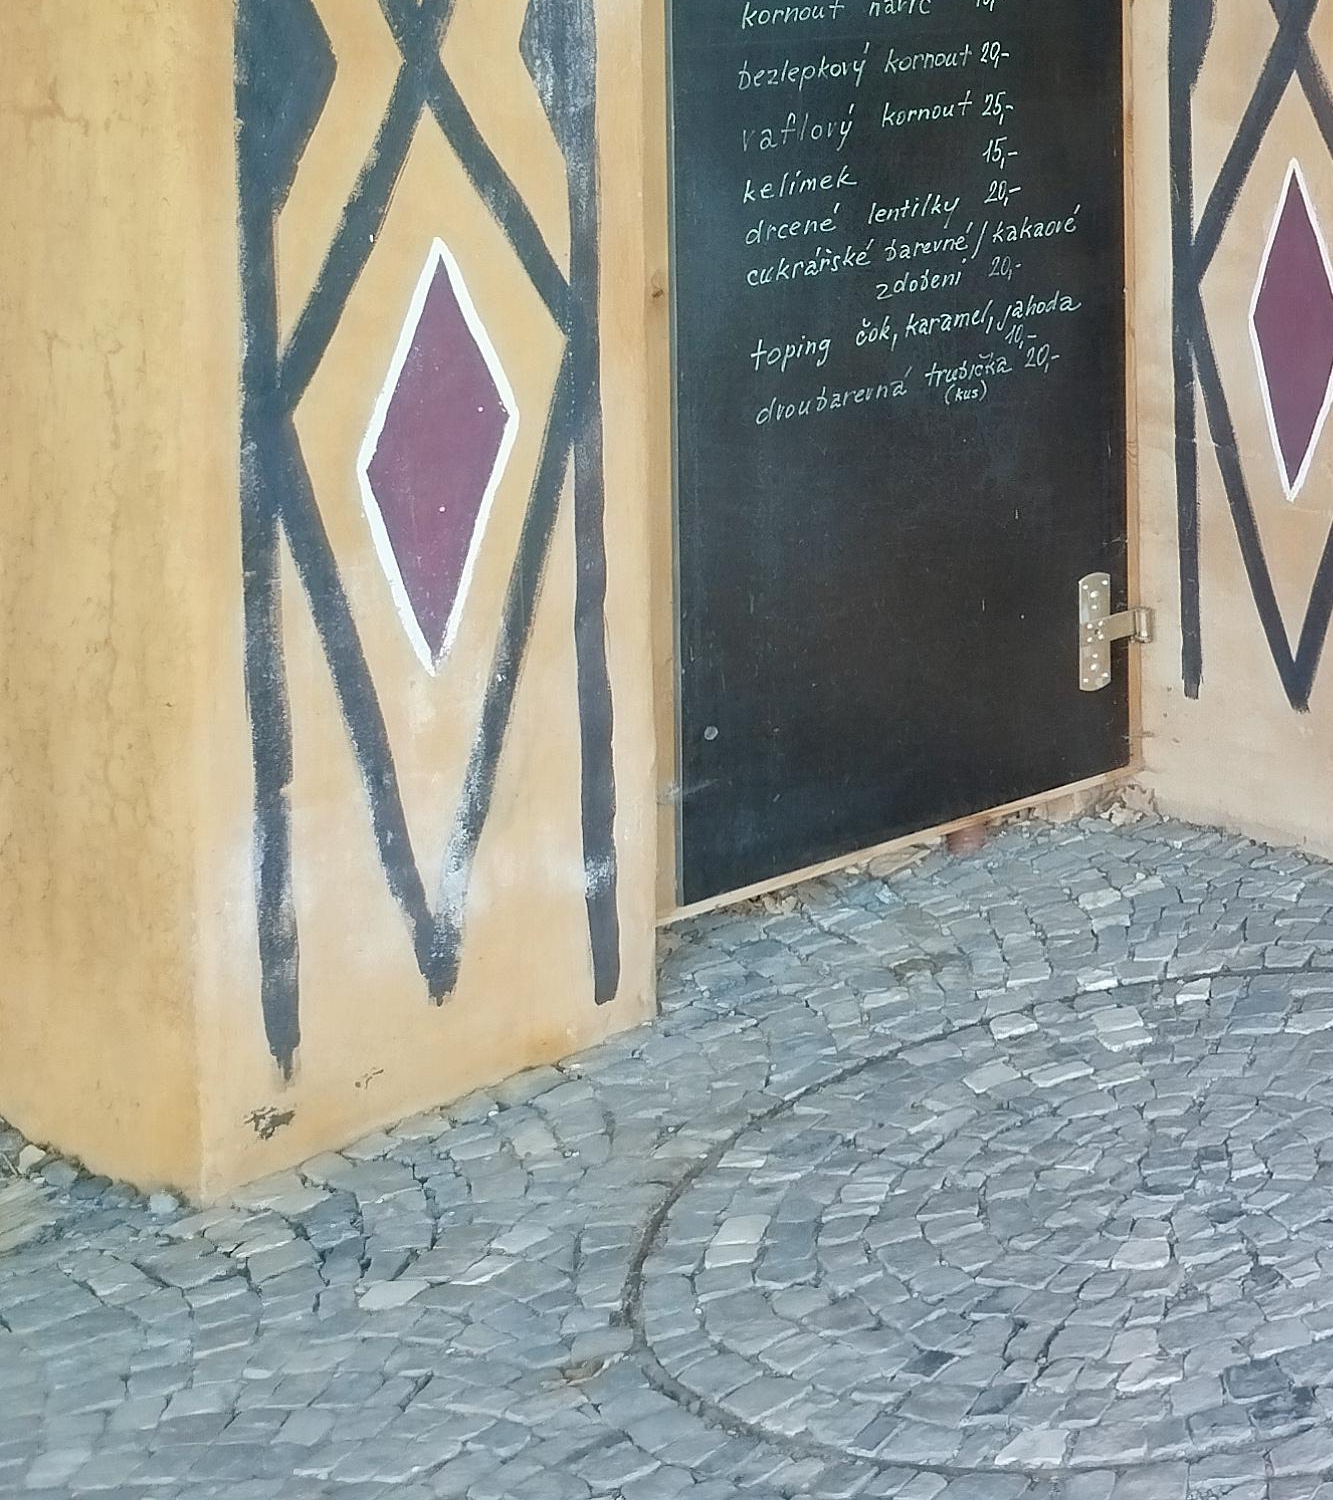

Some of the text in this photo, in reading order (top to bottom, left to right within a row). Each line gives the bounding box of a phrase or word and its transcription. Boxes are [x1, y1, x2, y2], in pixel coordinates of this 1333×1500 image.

[738, 42, 870, 92] bezlepkový
[885, 44, 972, 73] kornout
[742, 103, 854, 152] vaflový
[881, 90, 972, 128] kornout
[743, 165, 858, 203] kelímek
[745, 202, 840, 244] drcené
[867, 193, 960, 229] lentilky
[747, 239, 874, 286] cukrářské
[750, 334, 831, 372] toping
[996, 290, 1082, 331] jahoda
[755, 365, 912, 426] dvoubarevná
[925, 352, 1012, 387] trubička
[944, 383, 988, 405] (kus)
